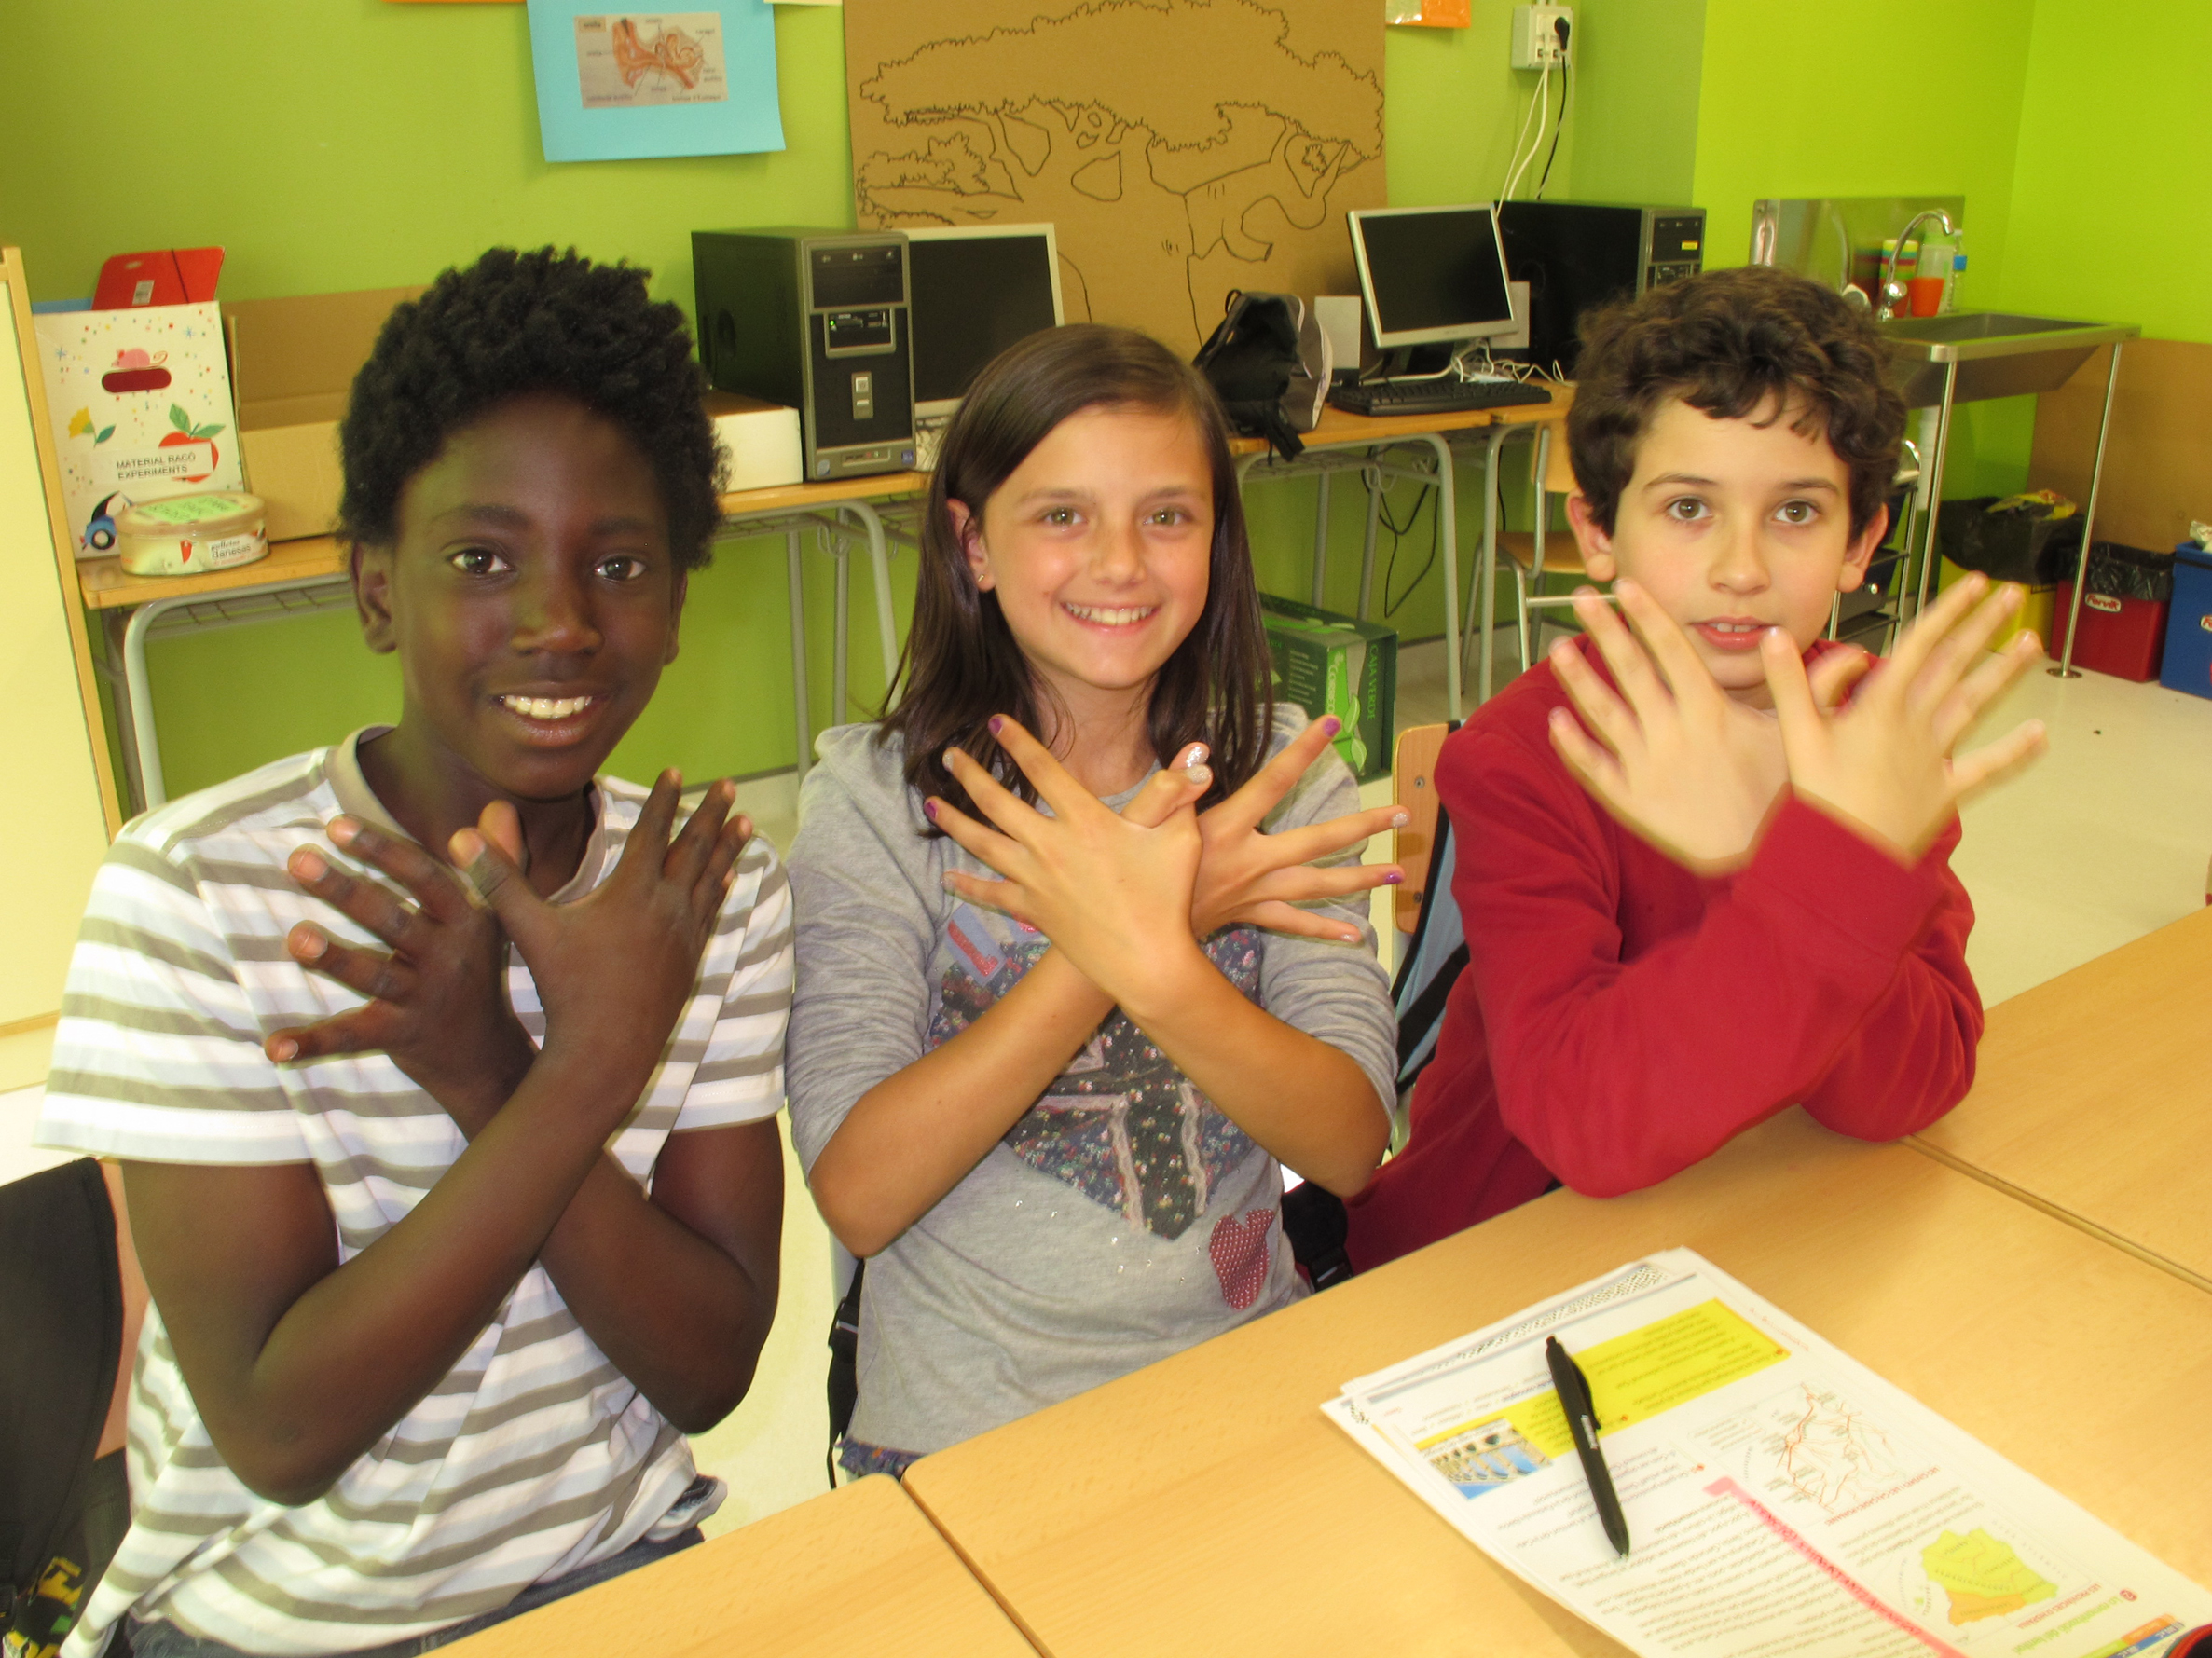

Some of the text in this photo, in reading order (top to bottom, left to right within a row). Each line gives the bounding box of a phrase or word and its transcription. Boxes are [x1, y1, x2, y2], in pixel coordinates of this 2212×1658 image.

[116, 456, 164, 469] MATERIAL
[117, 465, 187, 480] EXPERIMENTS
[212, 544, 251, 559] danesas
[1326, 664, 1338, 715] CORREO
[1367, 644, 1378, 721] CAJA VERDE
